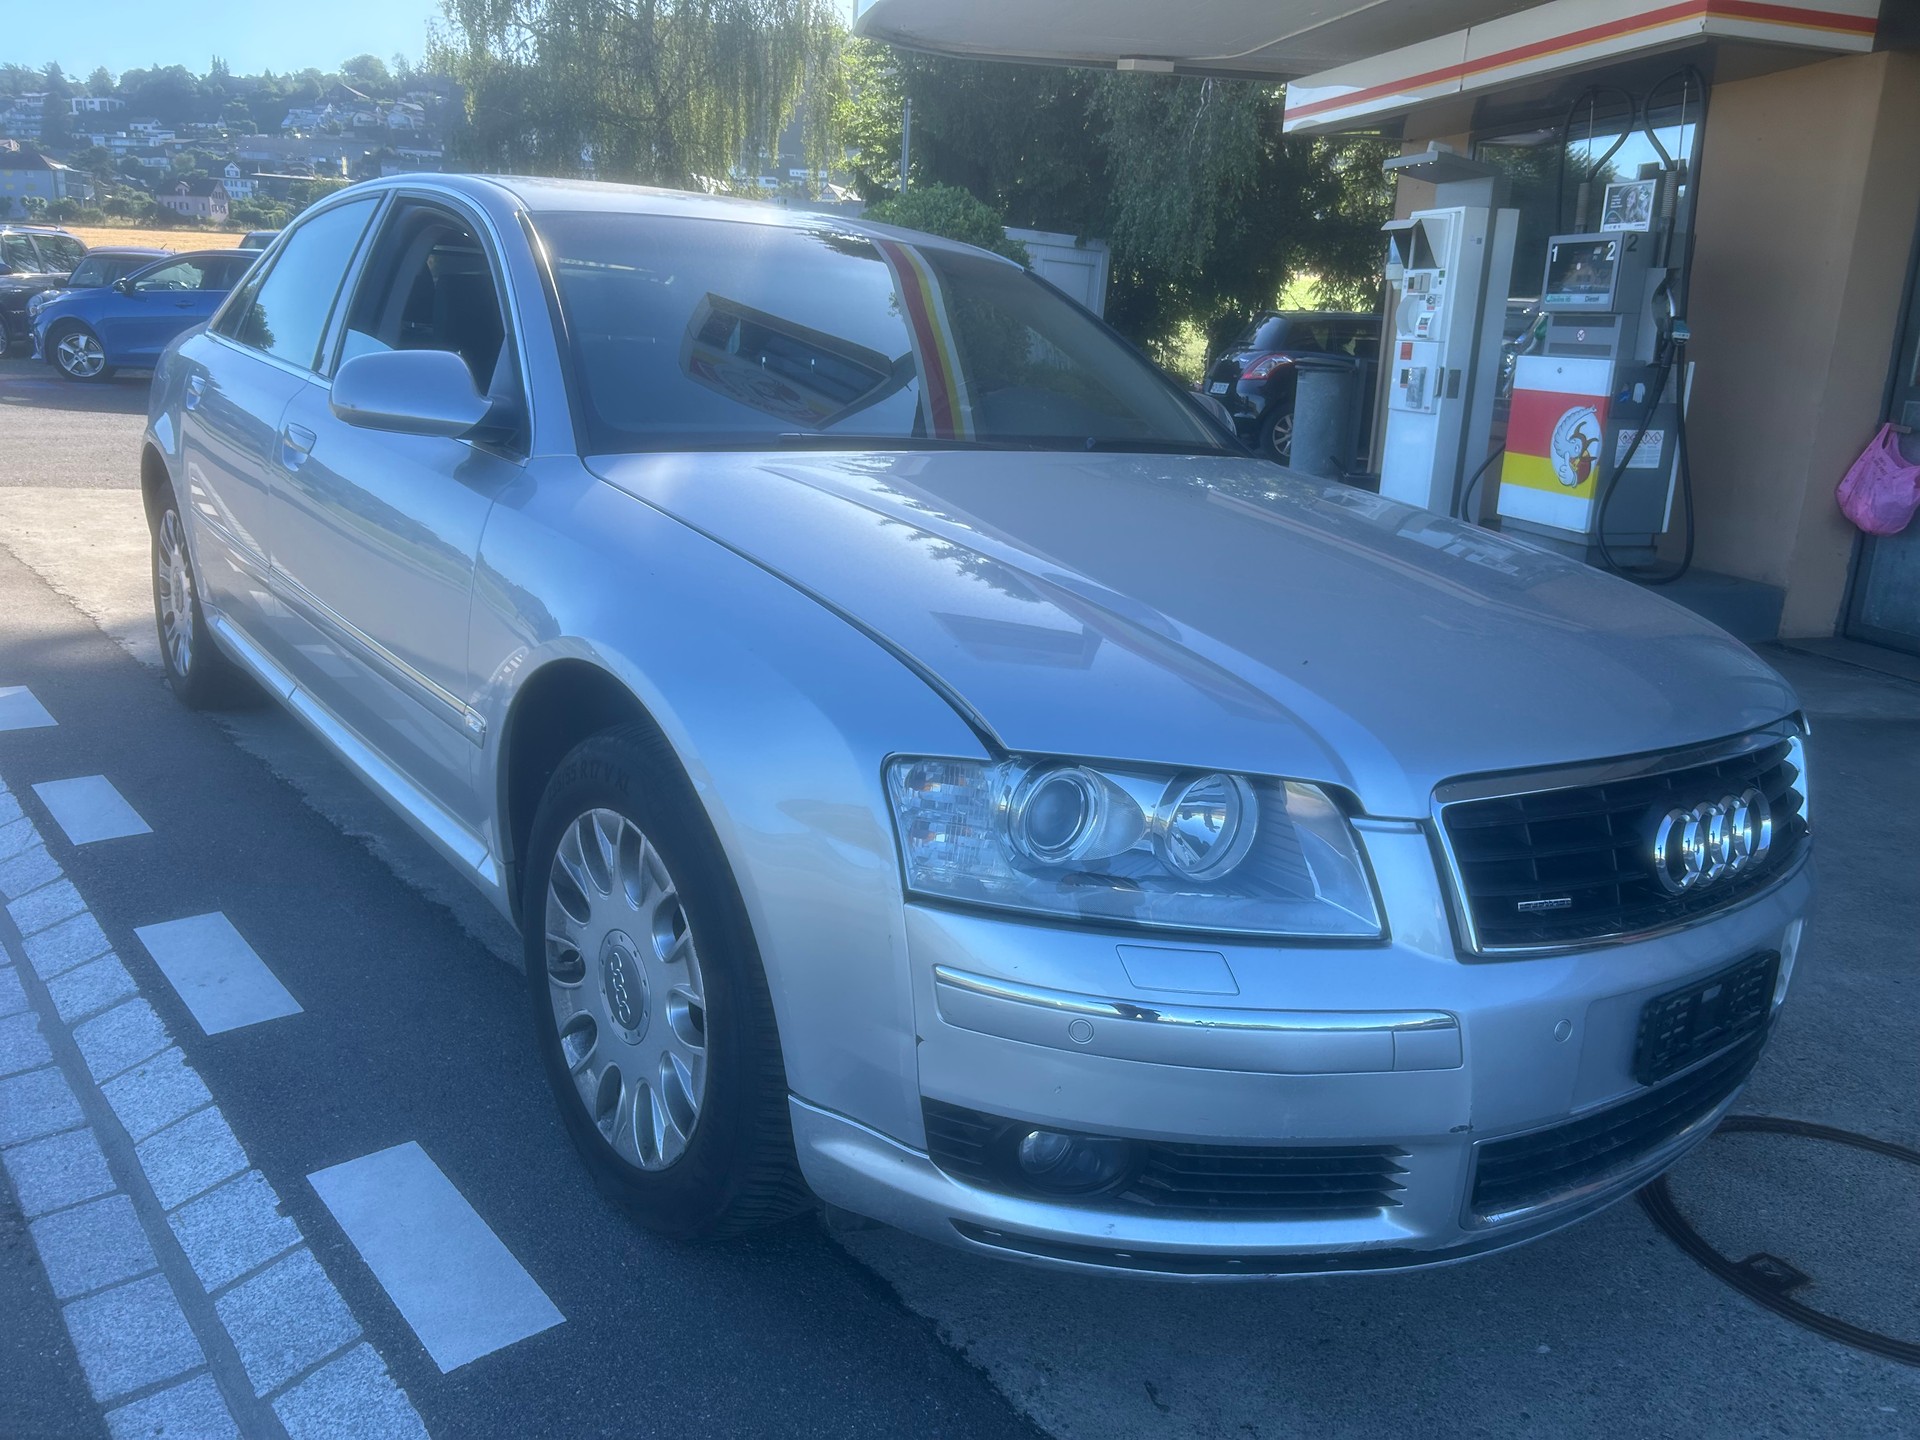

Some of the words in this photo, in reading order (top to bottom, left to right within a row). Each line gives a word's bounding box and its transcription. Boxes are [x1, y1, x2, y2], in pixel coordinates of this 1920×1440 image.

[1606, 241, 1616, 261] 2
[1626, 234, 1639, 252] 2
[1552, 245, 1558, 262] 1
